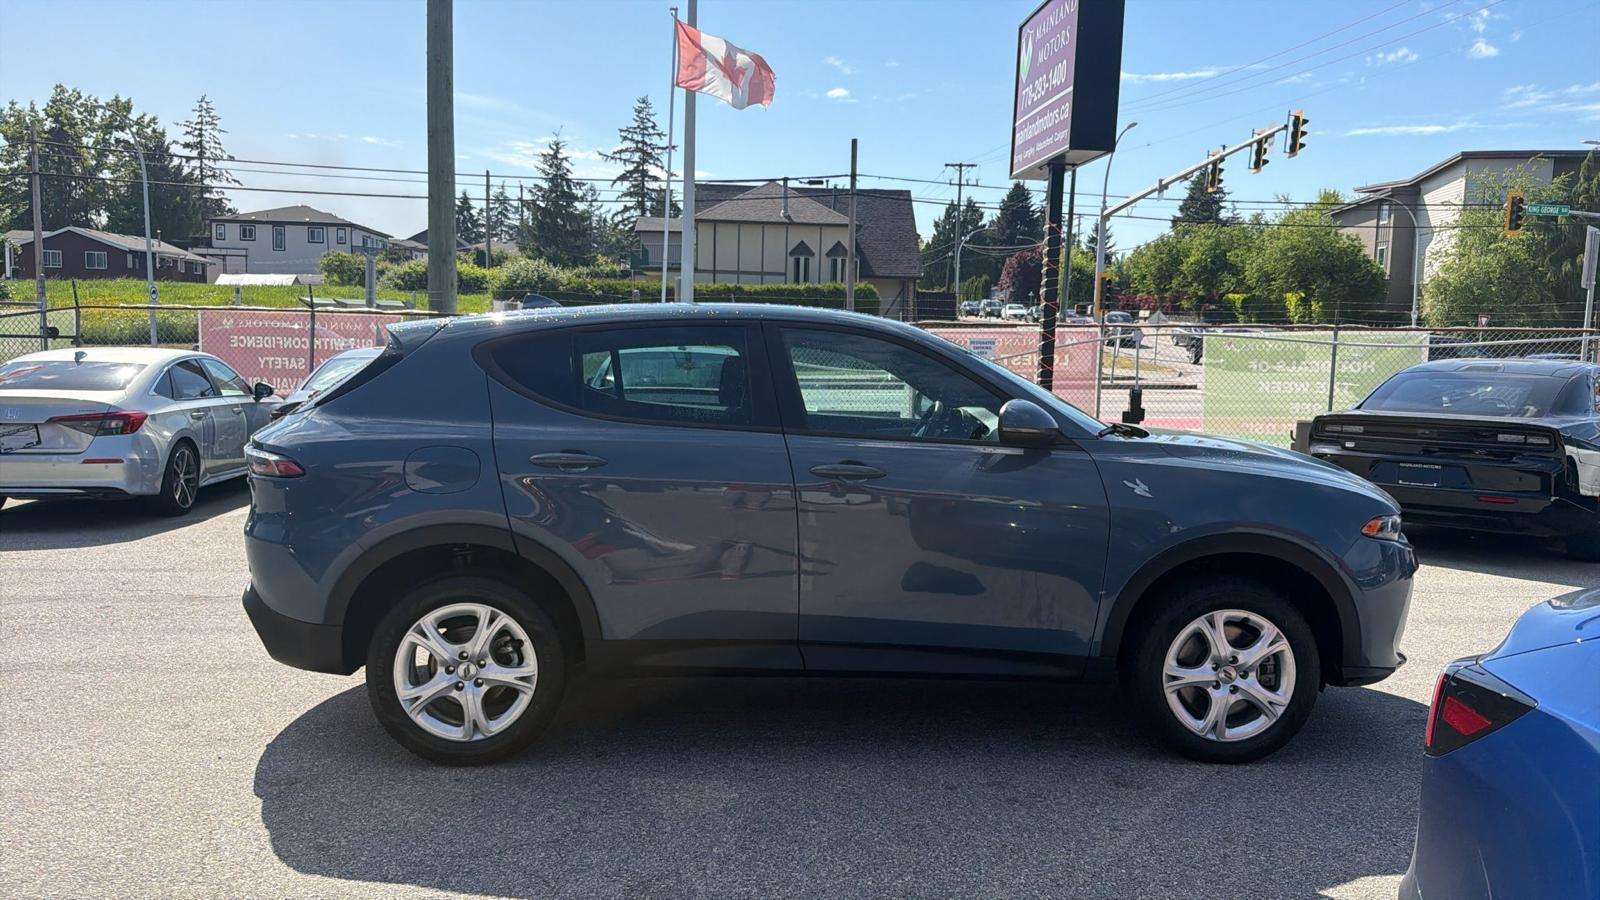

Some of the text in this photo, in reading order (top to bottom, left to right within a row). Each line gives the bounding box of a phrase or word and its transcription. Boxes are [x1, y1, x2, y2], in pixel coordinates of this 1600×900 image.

[1036, 0, 1077, 41] MAINLAND
[1038, 26, 1070, 66] MOTORS
[1022, 59, 1067, 110] 778-293-1400
[1541, 206, 1559, 214] GEORGE
